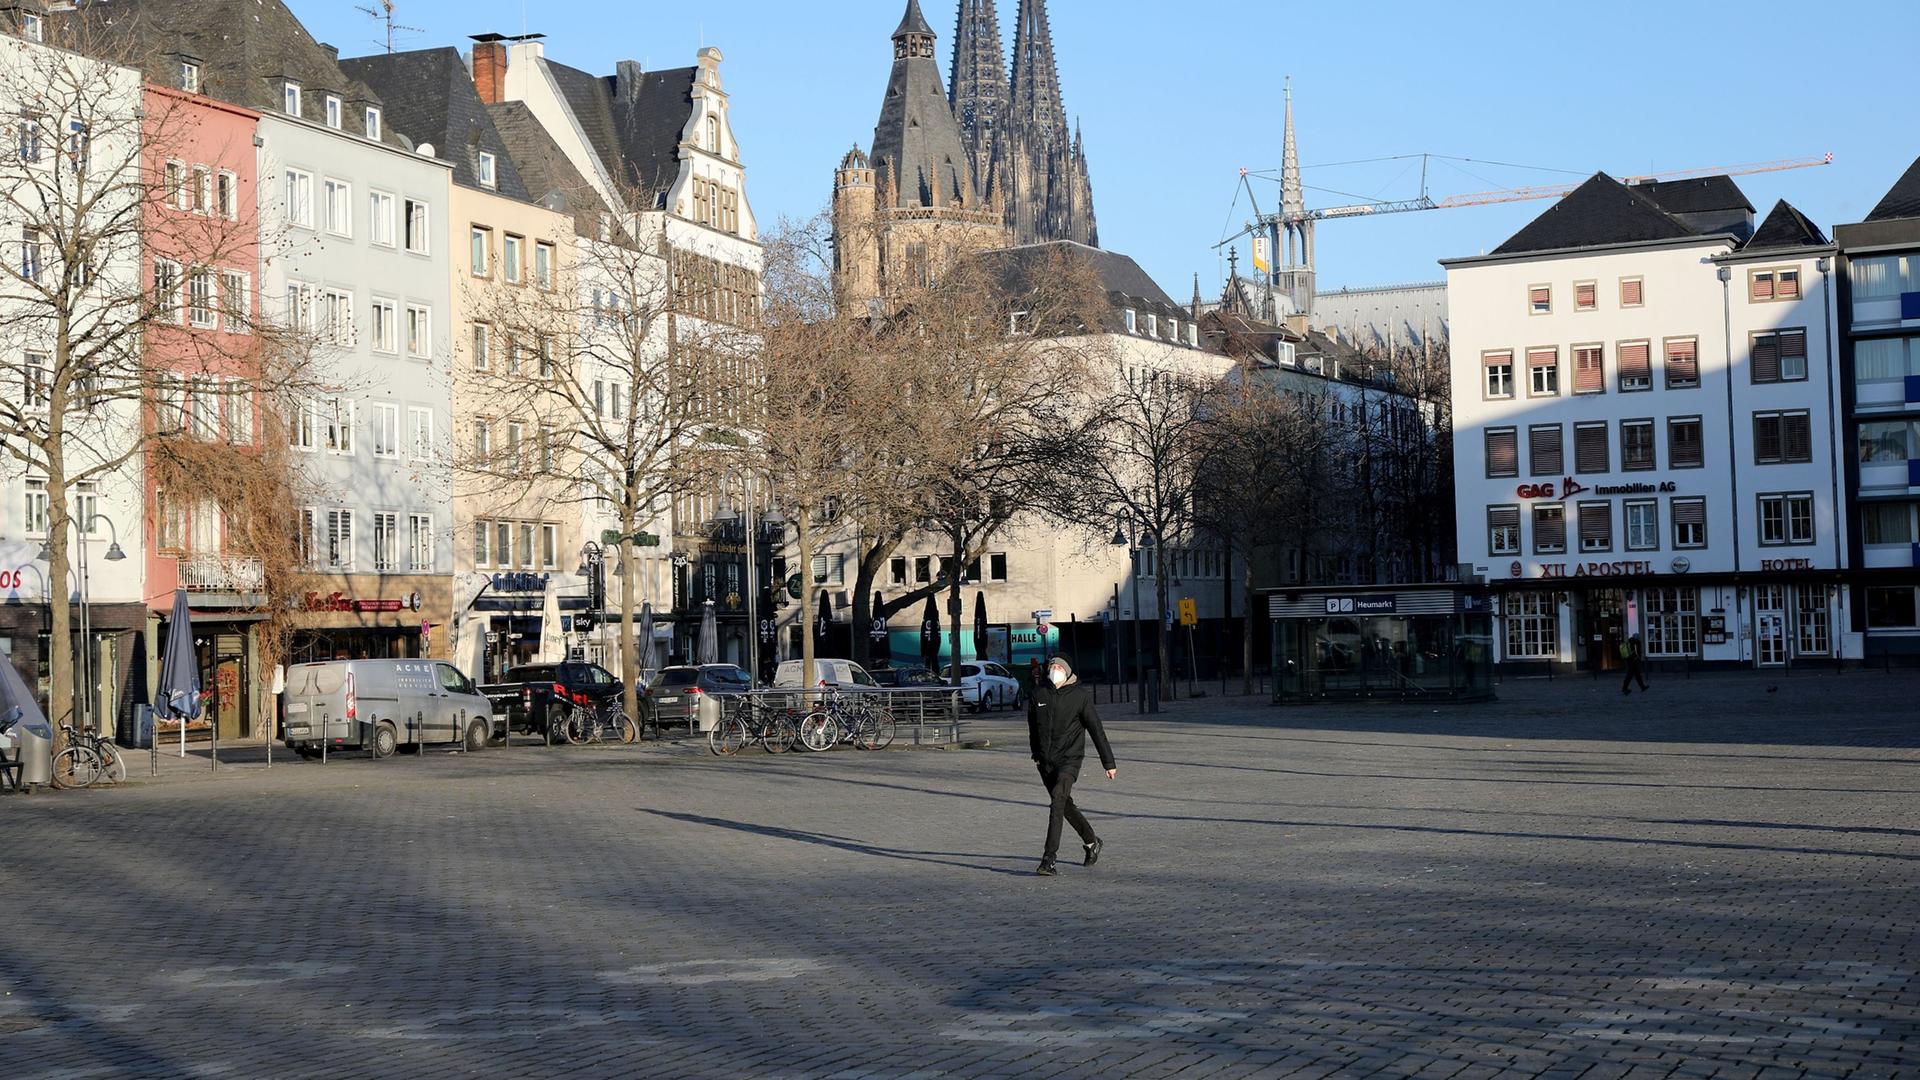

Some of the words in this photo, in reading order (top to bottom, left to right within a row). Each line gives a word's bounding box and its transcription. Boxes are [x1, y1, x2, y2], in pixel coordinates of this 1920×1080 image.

[1517, 483, 1554, 498] GAG
[1595, 483, 1656, 495] Immobilien
[1659, 481, 1676, 492] AG
[1540, 563, 1567, 579] XII
[1574, 561, 1655, 577] APOSTEL
[1760, 558, 1815, 572] HOTEL
[576, 618, 591, 628] sky
[1012, 634, 1036, 642] HALLE
